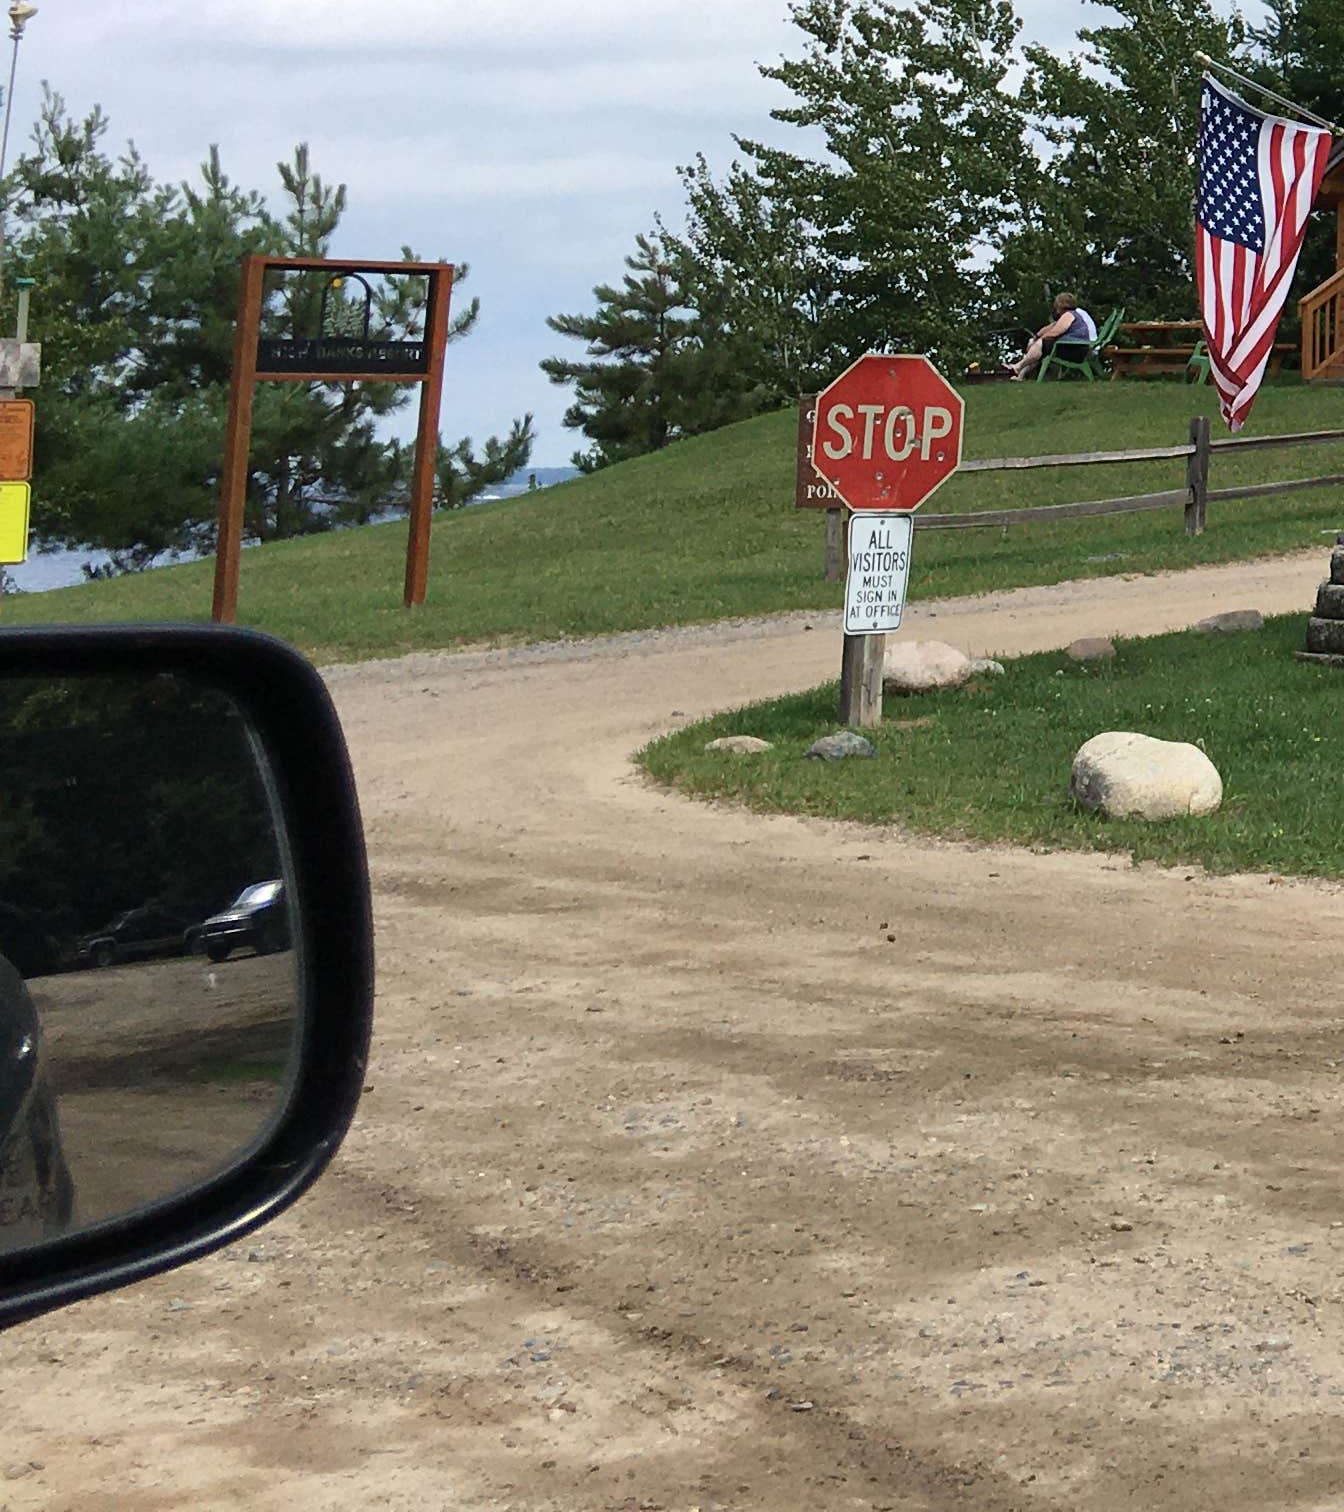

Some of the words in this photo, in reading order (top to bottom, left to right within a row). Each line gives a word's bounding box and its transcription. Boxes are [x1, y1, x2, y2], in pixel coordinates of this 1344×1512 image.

[822, 403, 953, 462] STOP
[868, 529, 893, 550] ALL
[853, 551, 906, 573] VISITORS
[862, 575, 893, 589] MUST
[856, 590, 883, 604] SIGN
[888, 590, 897, 603] IN
[850, 605, 861, 619] AT
[865, 603, 901, 619] OFFICE
